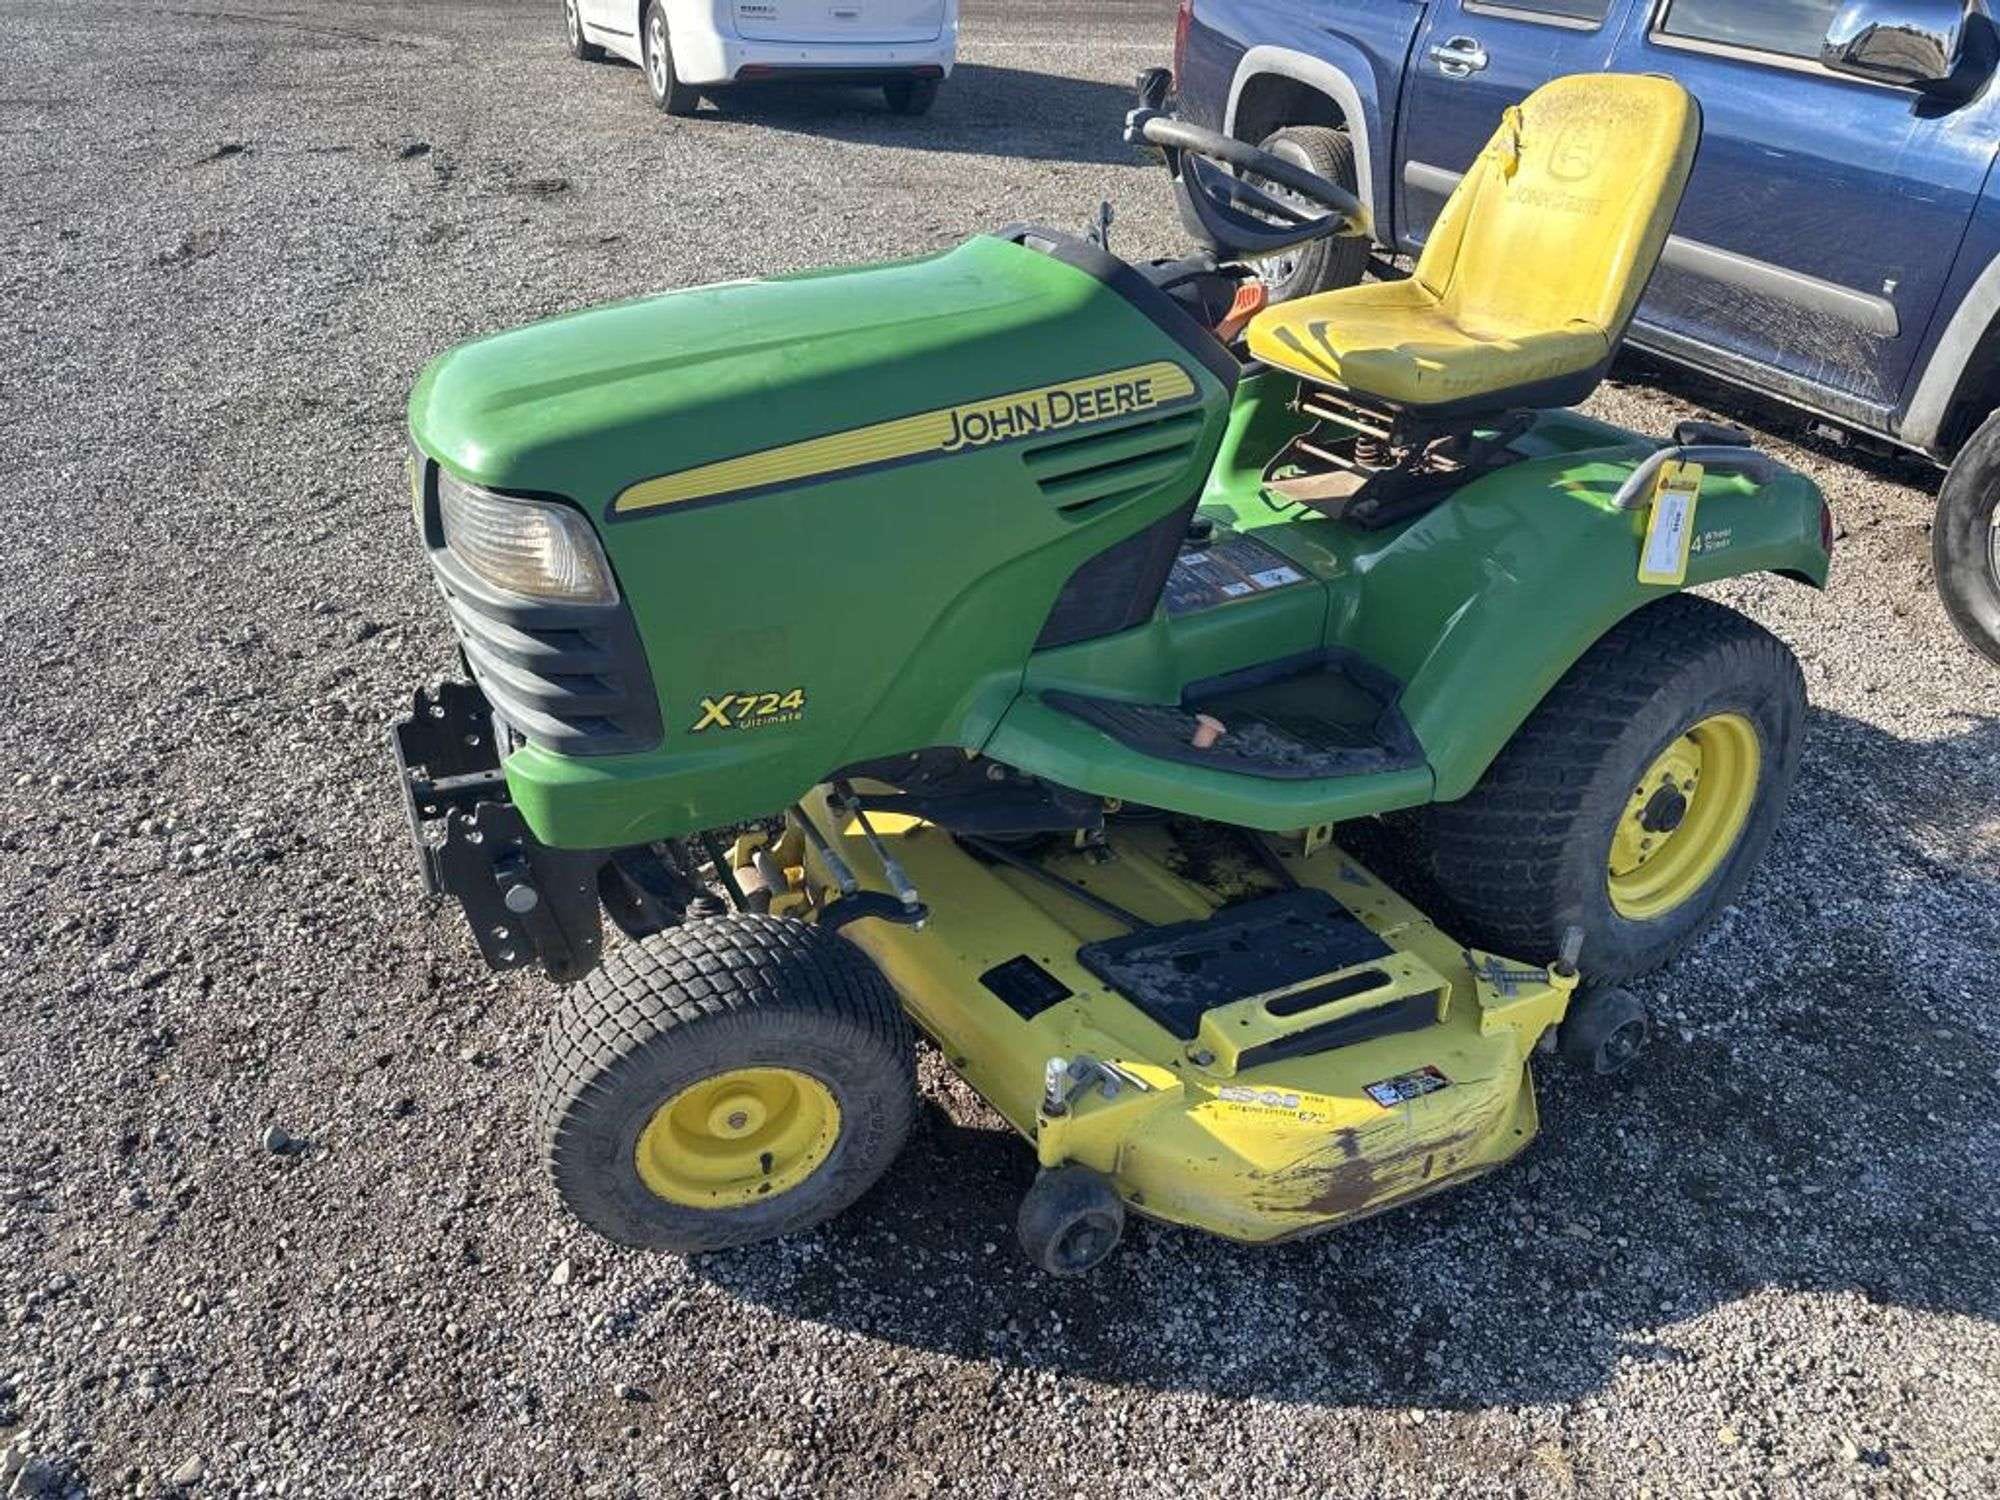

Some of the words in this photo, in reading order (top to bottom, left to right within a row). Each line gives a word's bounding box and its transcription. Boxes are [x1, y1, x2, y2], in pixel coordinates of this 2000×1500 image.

[942, 402, 1041, 448] JOHN
[1046, 379, 1154, 426] DEERE
[690, 688, 807, 733] X724
